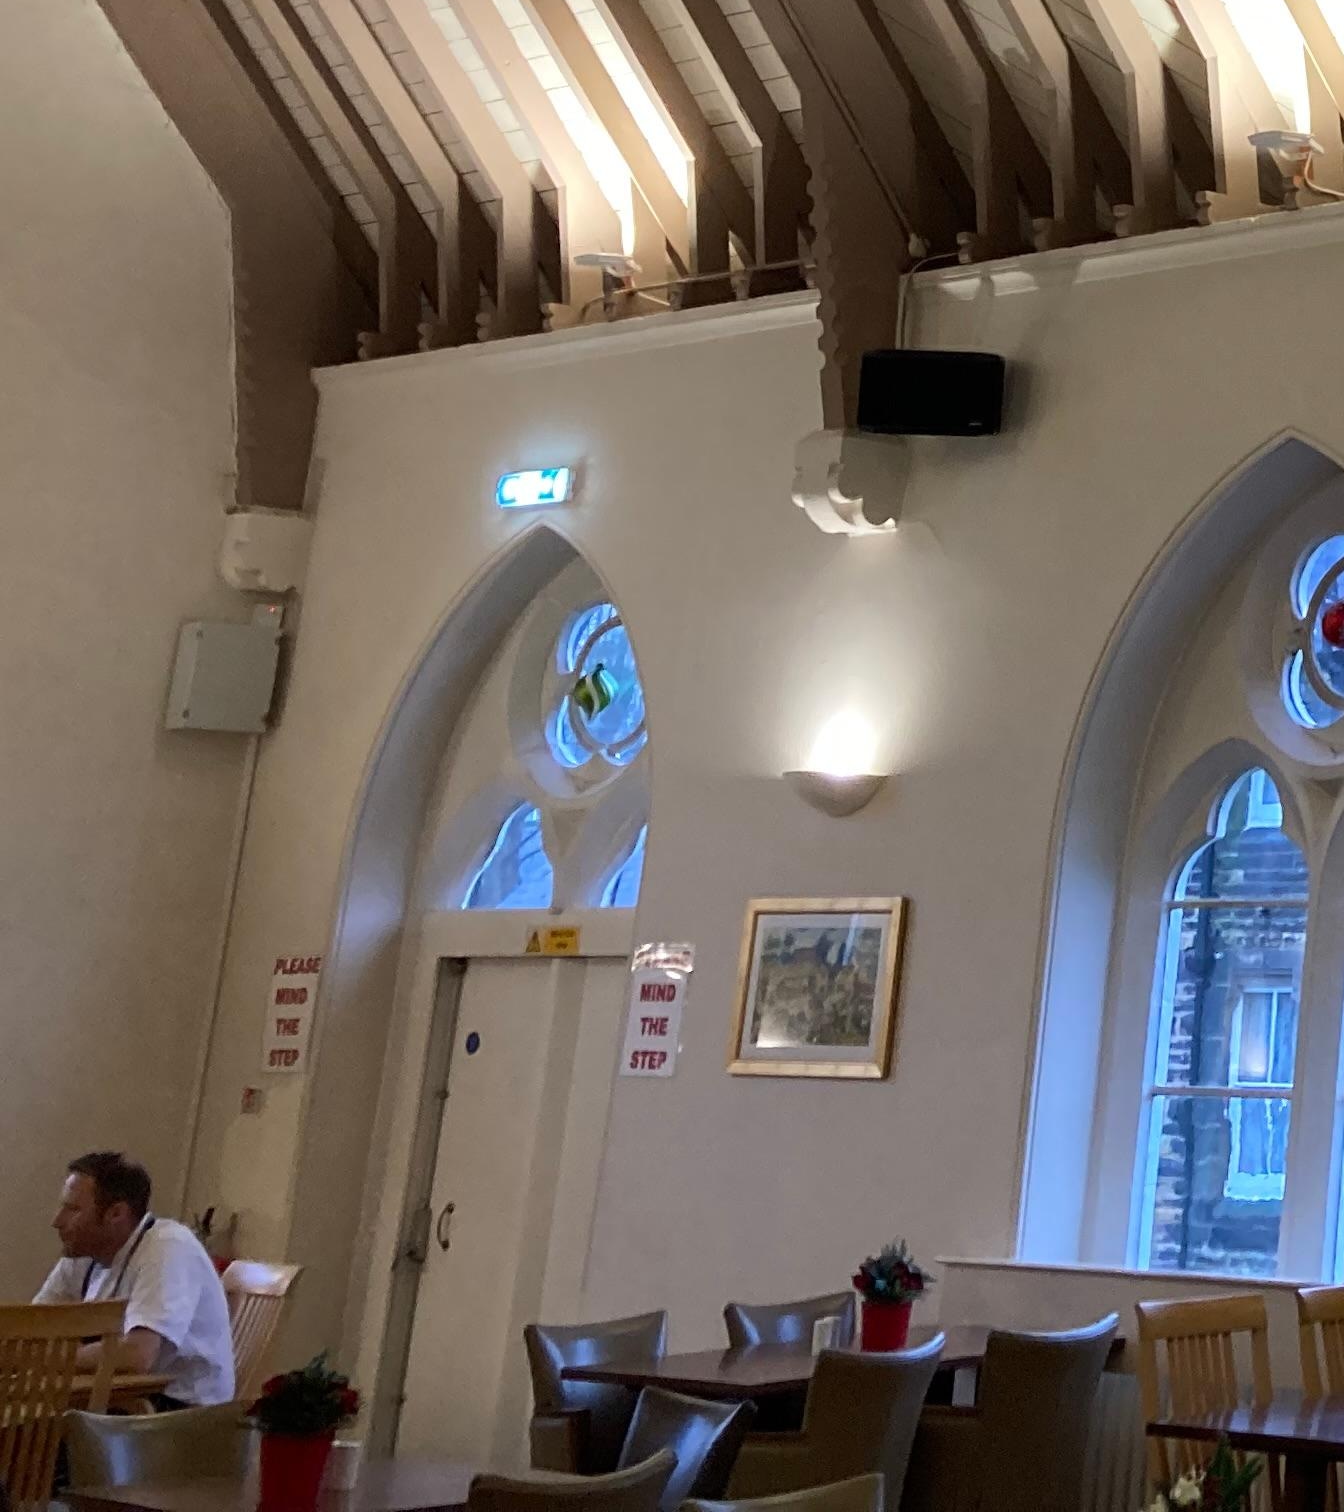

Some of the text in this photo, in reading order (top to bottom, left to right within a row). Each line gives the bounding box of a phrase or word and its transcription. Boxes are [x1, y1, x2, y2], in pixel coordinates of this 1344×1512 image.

[273, 956, 321, 976] PLEASE
[275, 987, 308, 1005] MIND
[640, 983, 677, 1002] MIND
[276, 1018, 300, 1036] THE
[640, 1016, 669, 1036] THE
[269, 1049, 300, 1067] STEP
[629, 1050, 668, 1069] STEP
